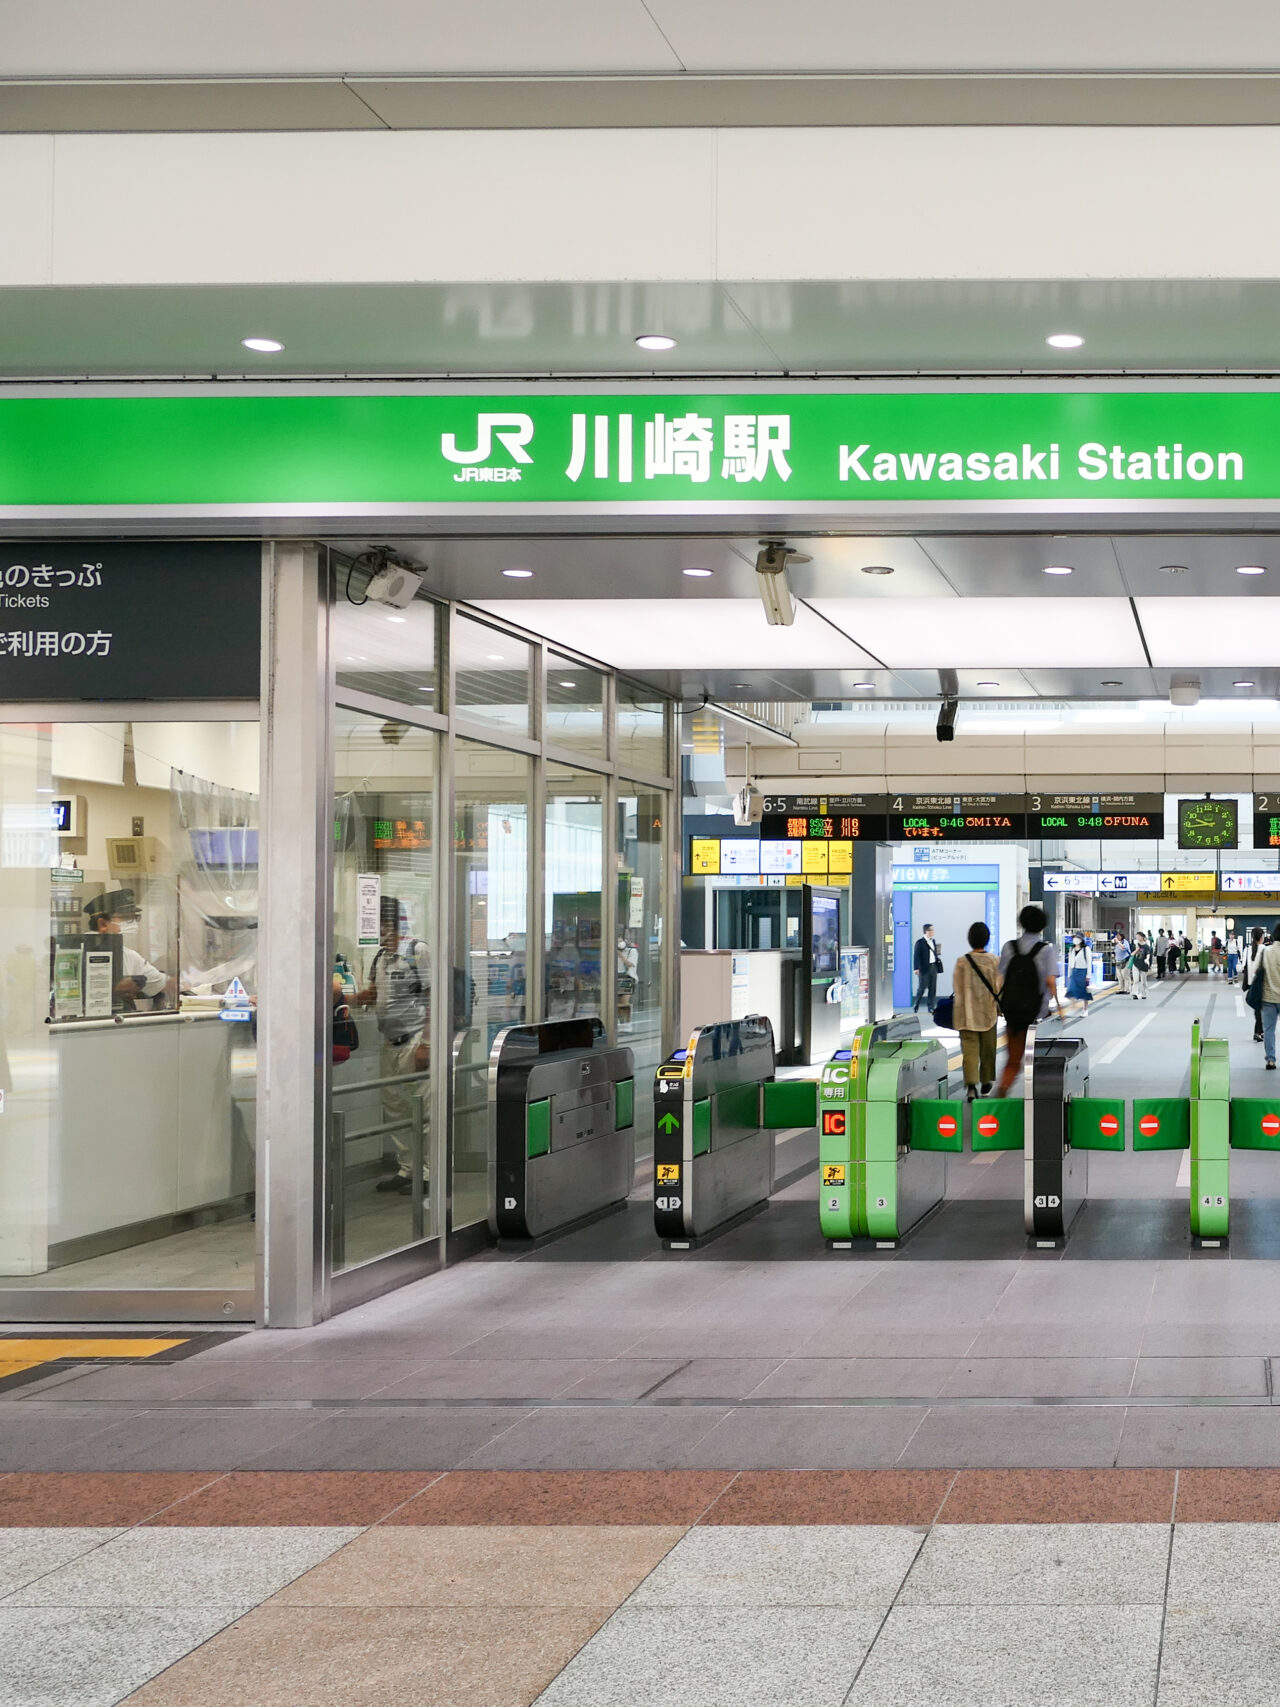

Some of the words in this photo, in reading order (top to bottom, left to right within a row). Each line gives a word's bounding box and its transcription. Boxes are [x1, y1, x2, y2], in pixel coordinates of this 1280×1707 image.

[441, 413, 534, 464] JR
[565, 412, 792, 484] 川崎駅
[839, 443, 1060, 482] Kawasaki
[1077, 442, 1243, 481] Station
[453, 467, 522, 482] JR東日本
[0, 563, 103, 588] のきっぷ
[892, 797, 904, 811] 4
[1031, 796, 1042, 811] 3
[1258, 796, 1268, 811] 2
[903, 818, 930, 828] LOCAL
[940, 817, 964, 828] 9:46
[1041, 817, 1068, 827] LOCAL
[1078, 817, 1103, 827] 9:48
[823, 1068, 849, 1084] IC
[823, 1087, 845, 1098] 専用
[824, 1114, 845, 1134] IC
